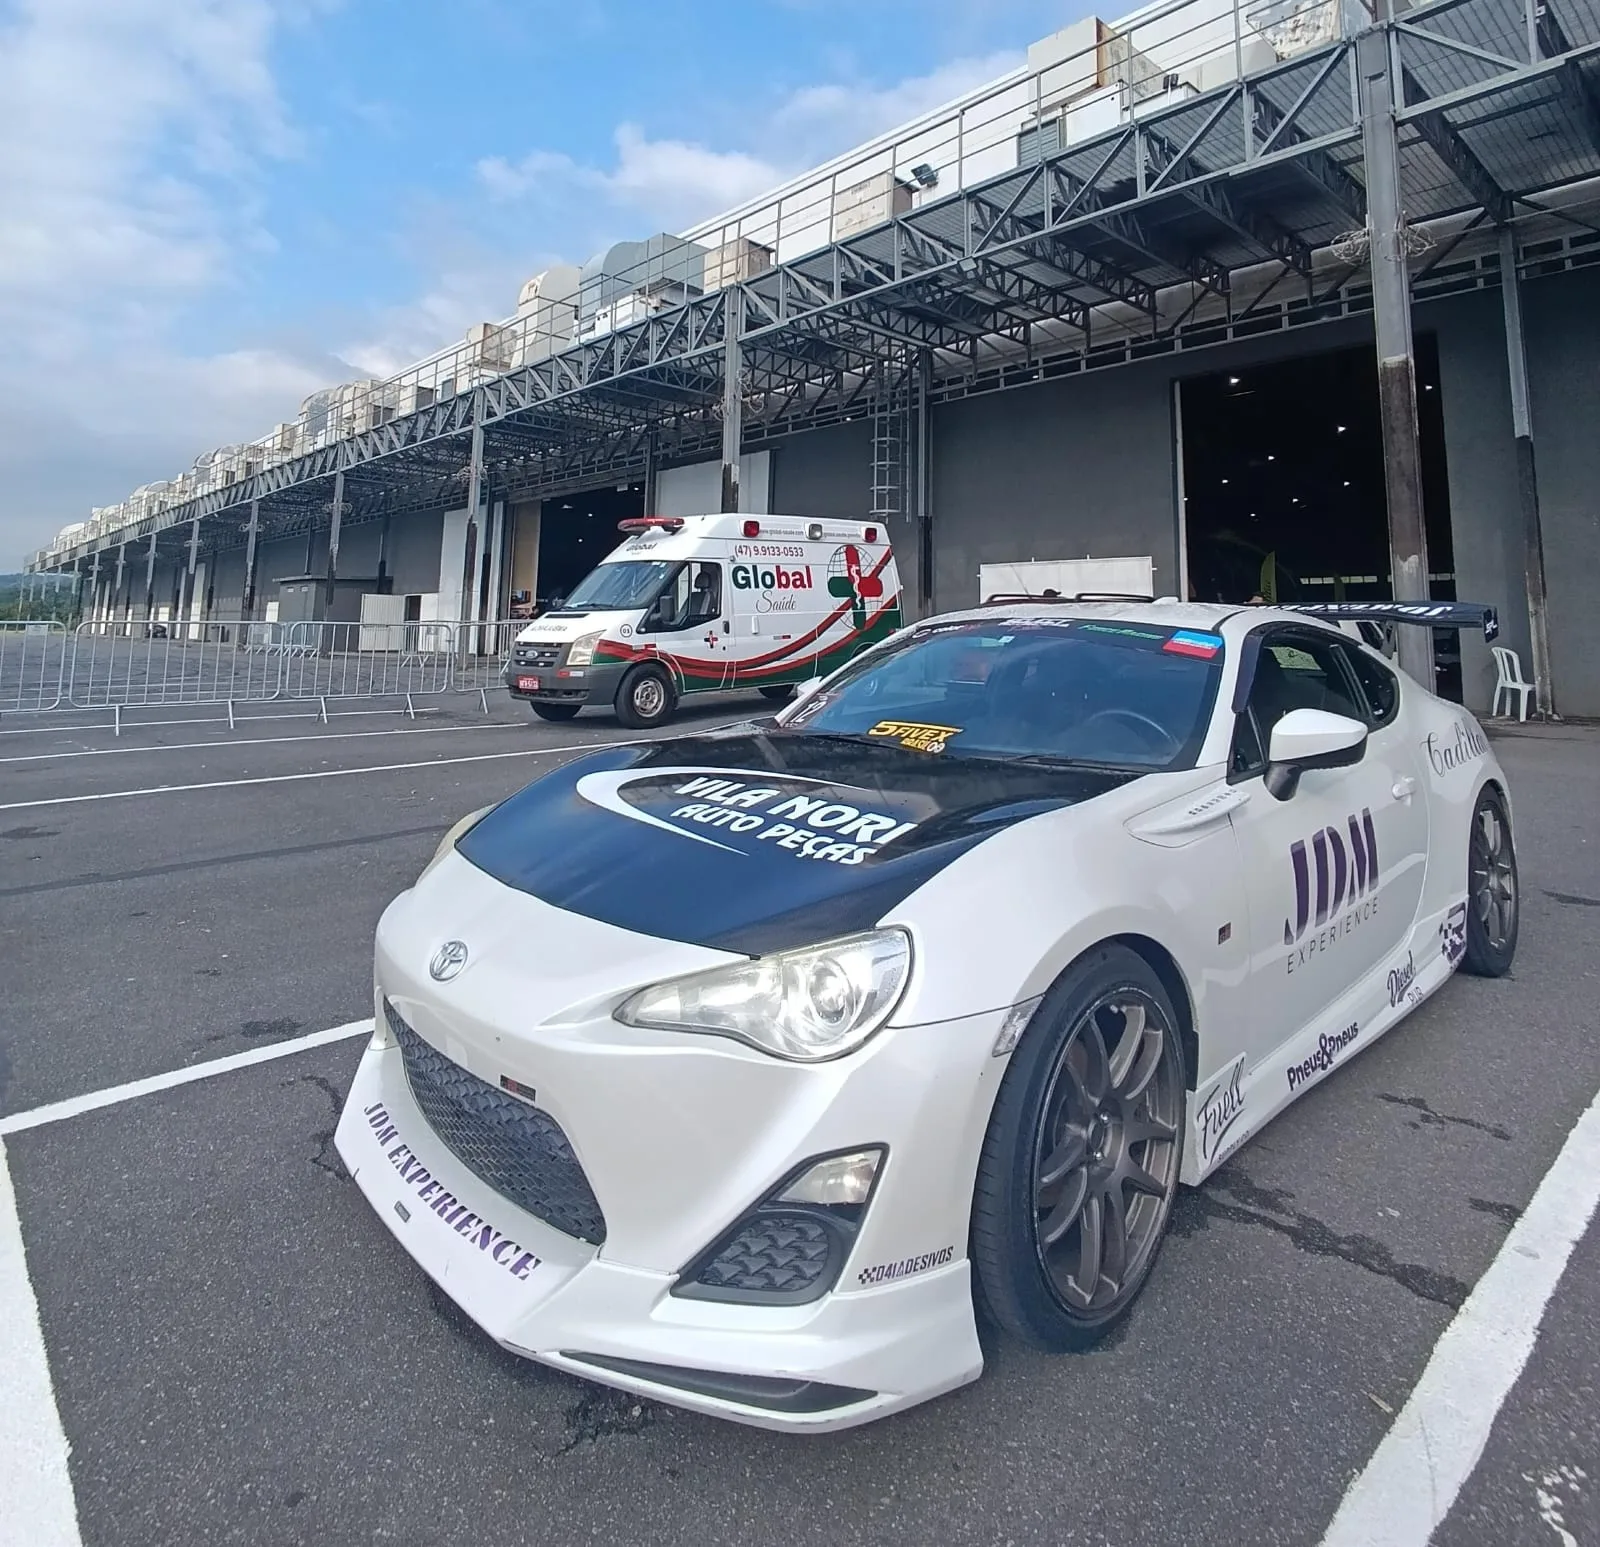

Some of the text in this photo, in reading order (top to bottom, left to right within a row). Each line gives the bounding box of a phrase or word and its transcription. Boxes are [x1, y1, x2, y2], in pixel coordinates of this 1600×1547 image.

[731, 564, 813, 590] Global
[734, 545, 752, 557] (47)
[755, 590, 797, 614] Saúde
[670, 803, 879, 865] AUTO PEÇAS
[674, 776, 919, 845] VILA NORI
[1283, 807, 1379, 946] JDM
[1286, 896, 1379, 974] EXPERIENCE
[364, 1102, 542, 1281] JDM EXPERIENCE
